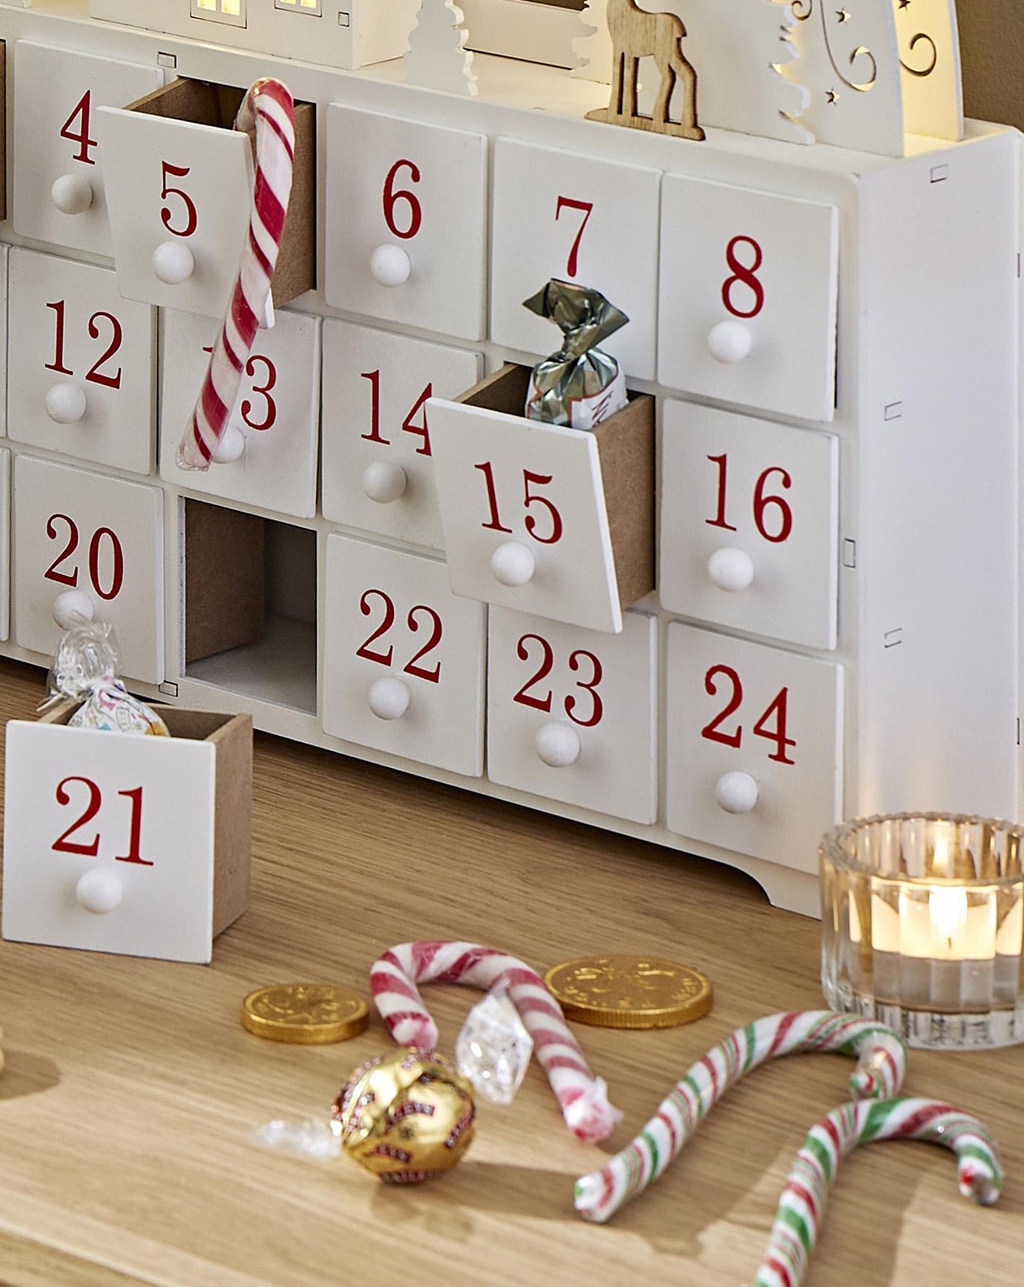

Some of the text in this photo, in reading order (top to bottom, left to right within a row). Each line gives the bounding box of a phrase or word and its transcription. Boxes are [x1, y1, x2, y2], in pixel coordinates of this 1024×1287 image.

[60, 91, 97, 164] 4
[161, 162, 197, 237] 5
[383, 159, 422, 239] 6
[556, 196, 593, 277] 7
[721, 235, 764, 318] 8
[45, 301, 122, 389] 12
[203, 347, 276, 430] 3
[362, 370, 432, 456] 14
[475, 461, 562, 544] 15
[706, 454, 792, 543] 16
[45, 514, 123, 600] 20
[356, 589, 442, 682] 22
[513, 634, 602, 727] 23
[701, 664, 796, 765] 24
[51, 776, 154, 866] 21
